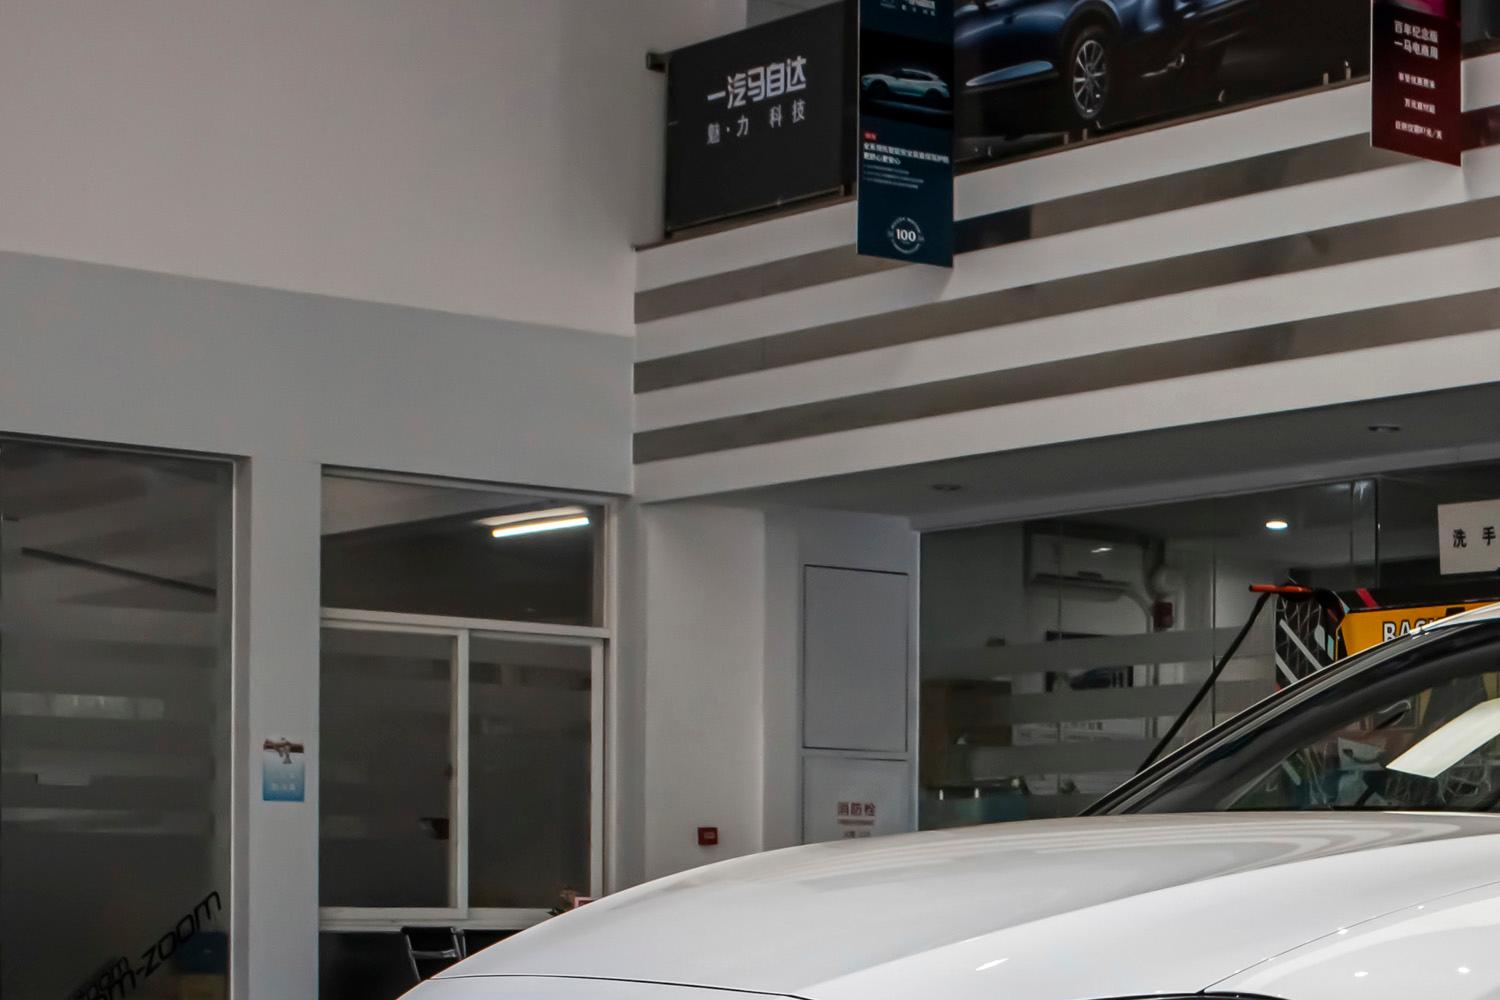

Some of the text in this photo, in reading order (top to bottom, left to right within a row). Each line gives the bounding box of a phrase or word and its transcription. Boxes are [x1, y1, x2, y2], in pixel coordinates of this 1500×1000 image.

[707, 56, 807, 109] 一汽马自达
